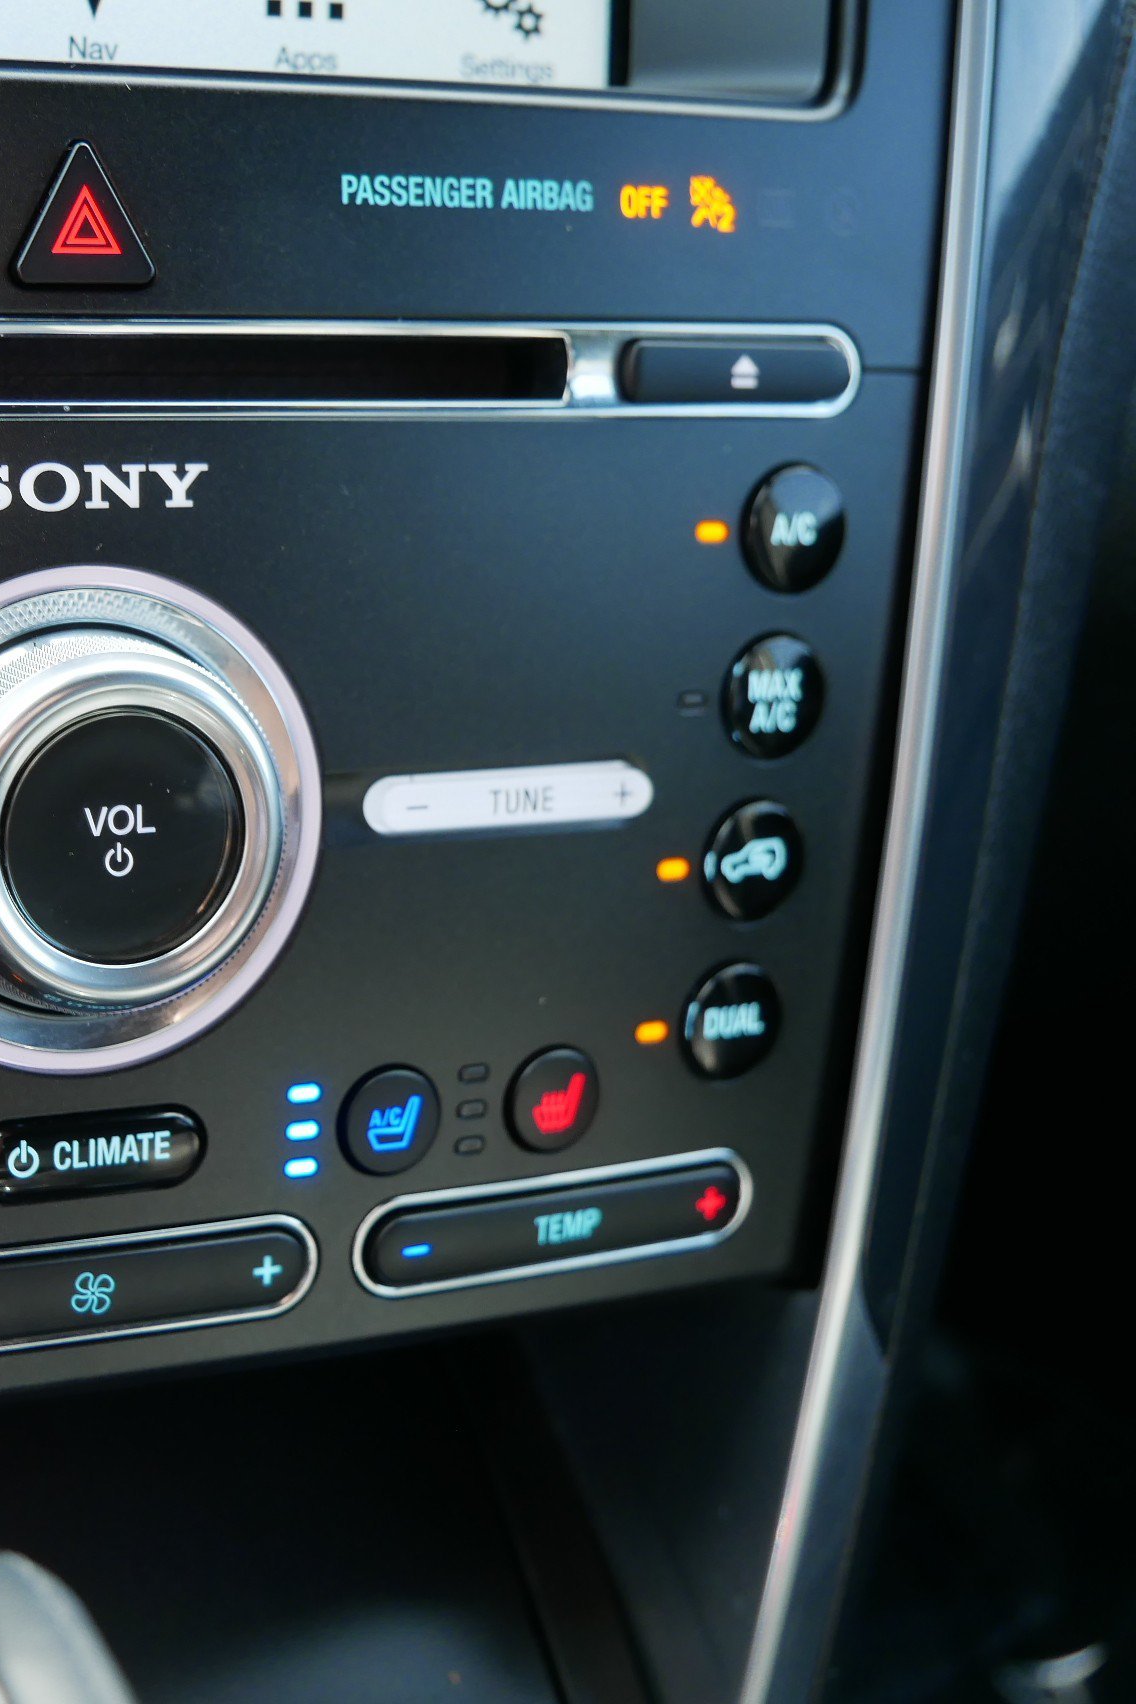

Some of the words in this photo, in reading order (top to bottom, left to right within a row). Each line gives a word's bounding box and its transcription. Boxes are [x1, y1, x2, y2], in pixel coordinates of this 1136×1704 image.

[68, 34, 118, 63] Nav
[274, 46, 338, 73] Apps
[459, 53, 554, 83] Settings
[340, 173, 495, 209] PASSENGER
[499, 179, 595, 213] AIRBAG
[619, 186, 667, 218] OFF
[770, 512, 819, 547] A/C
[748, 669, 803, 702] MAX
[751, 702, 797, 732] A/C
[489, 786, 556, 815] TUNE
[84, 803, 157, 837] VOL
[702, 1002, 766, 1040] DUAL
[368, 1106, 402, 1129] A/C
[52, 1131, 172, 1172] CLIMATE
[533, 1208, 604, 1246] TEMP
